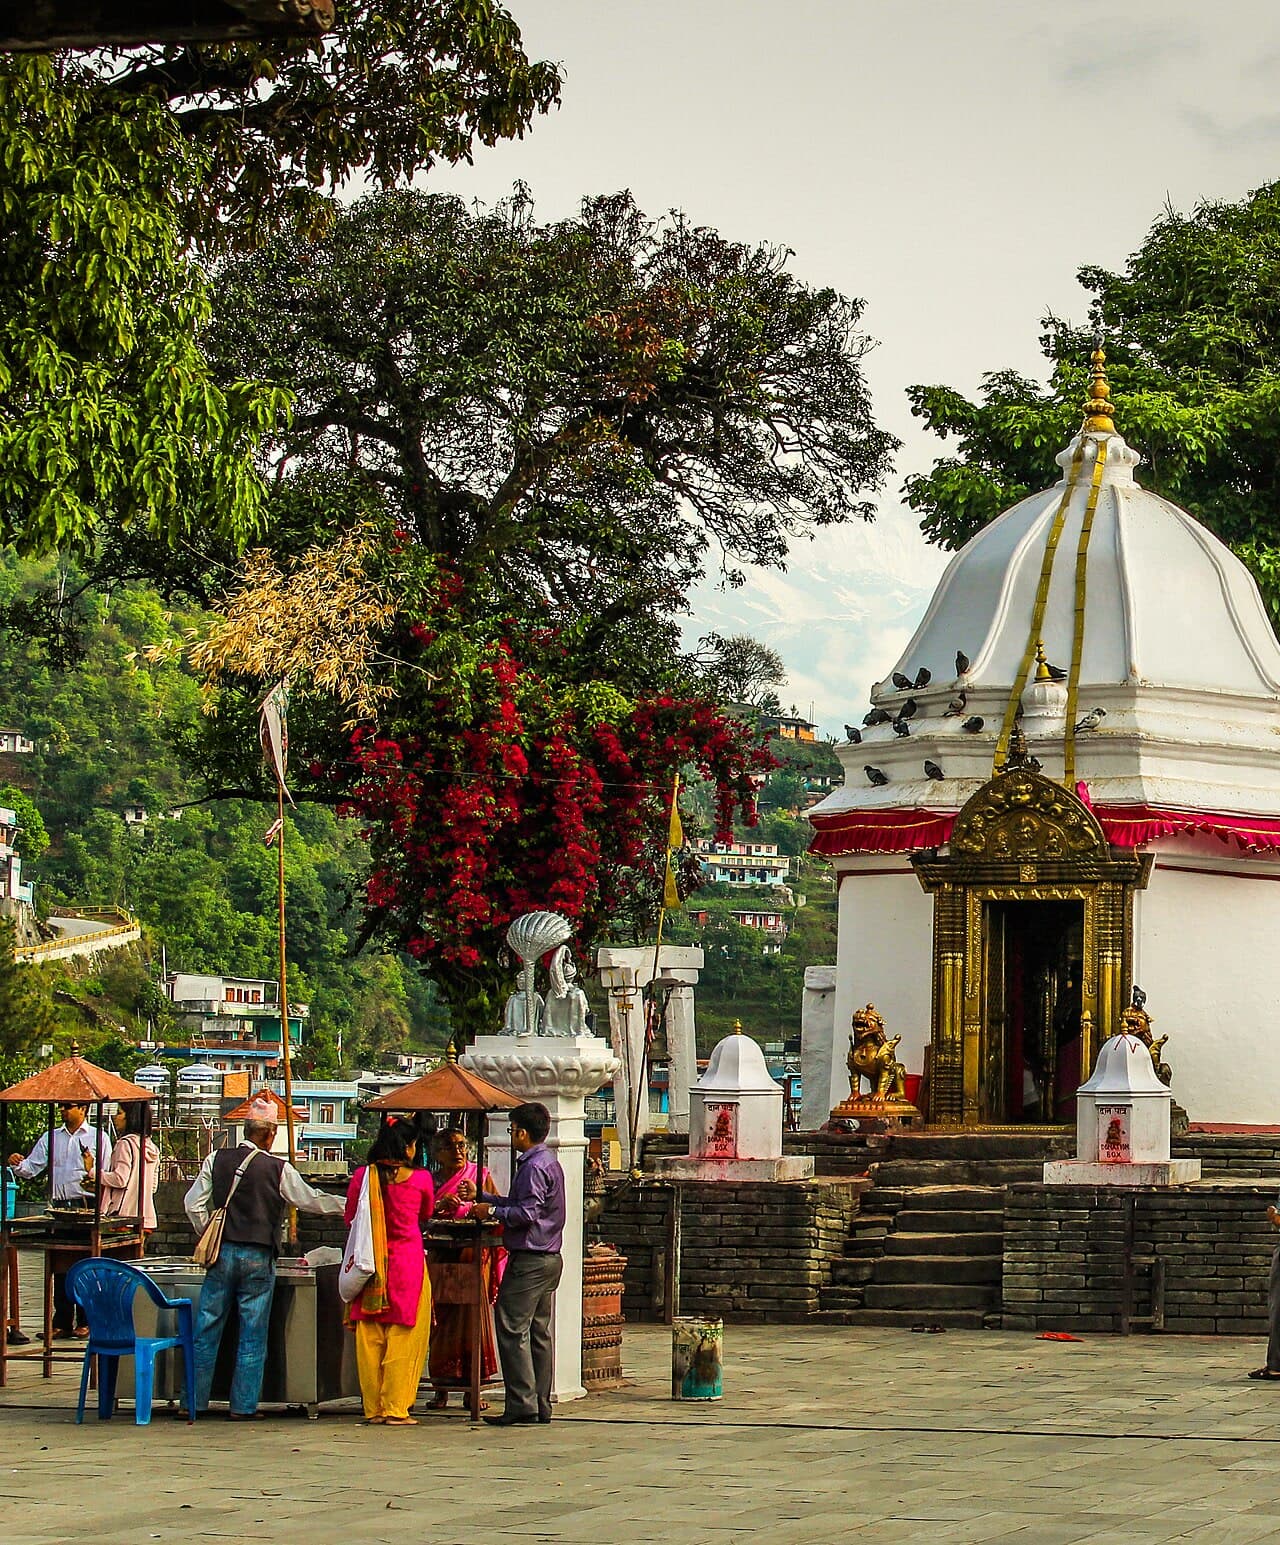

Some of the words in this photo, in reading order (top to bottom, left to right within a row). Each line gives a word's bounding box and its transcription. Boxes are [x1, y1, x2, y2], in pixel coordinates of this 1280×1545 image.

[1099, 1107, 1112, 1115] दान
[714, 1143, 728, 1151] BOX
[1106, 1150, 1122, 1159] BOX
